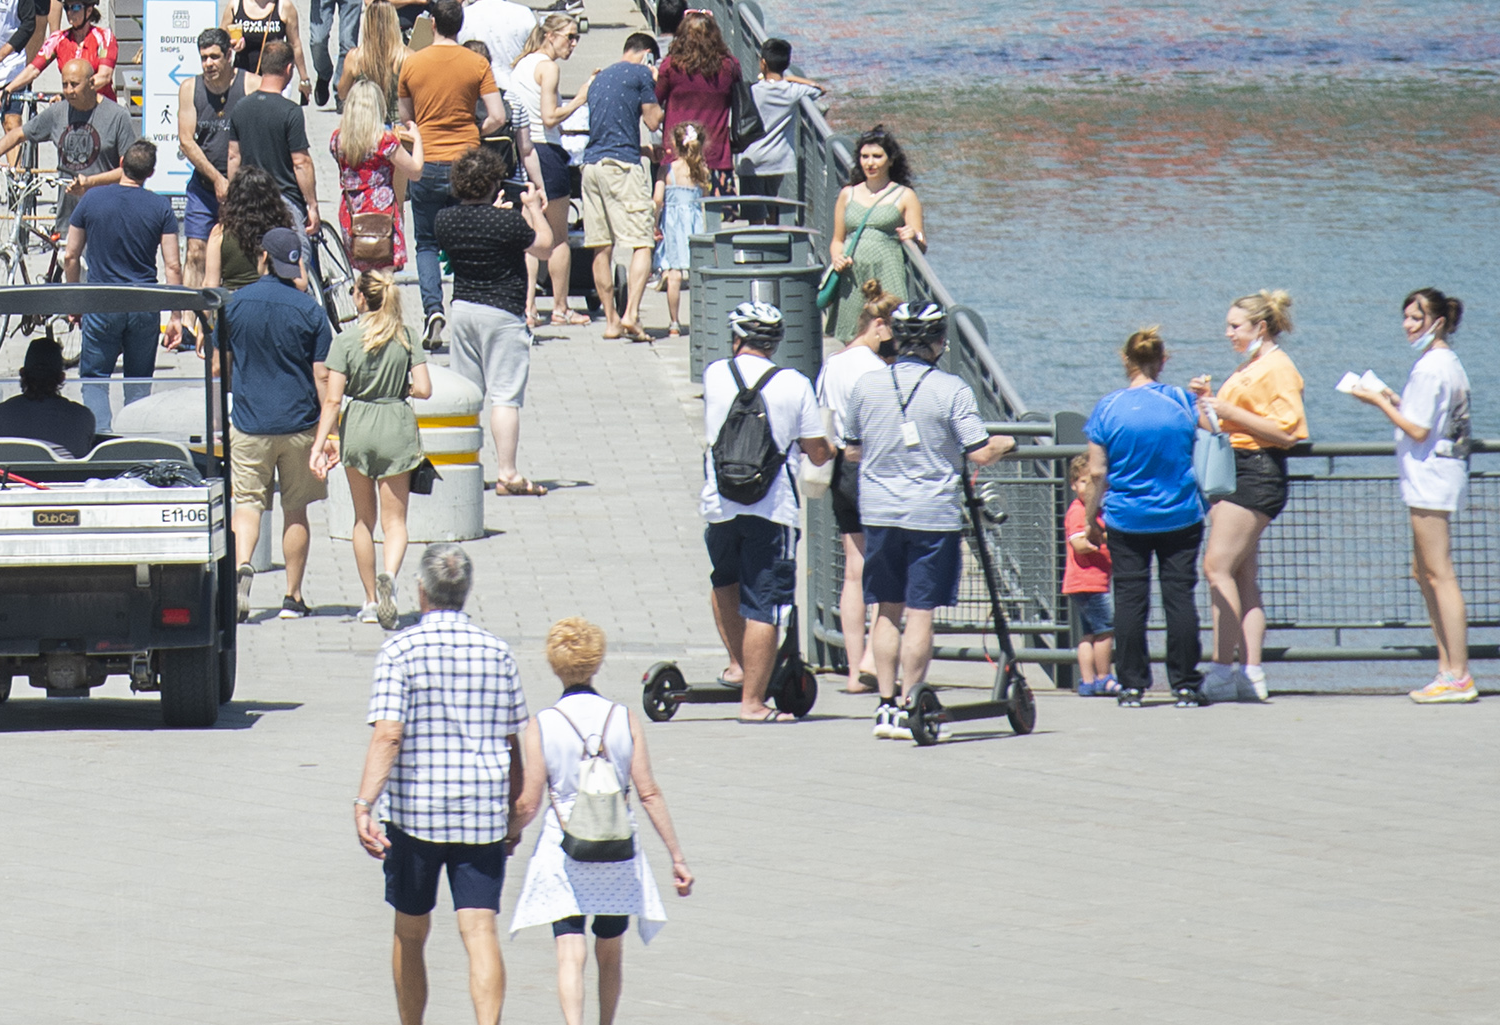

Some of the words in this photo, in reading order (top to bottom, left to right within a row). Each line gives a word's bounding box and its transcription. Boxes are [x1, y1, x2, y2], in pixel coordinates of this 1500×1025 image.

[153, 133, 170, 142] VOIE
[37, 513, 58, 523] Club
[59, 514, 76, 523] Car
[161, 509, 207, 523] E11-06
